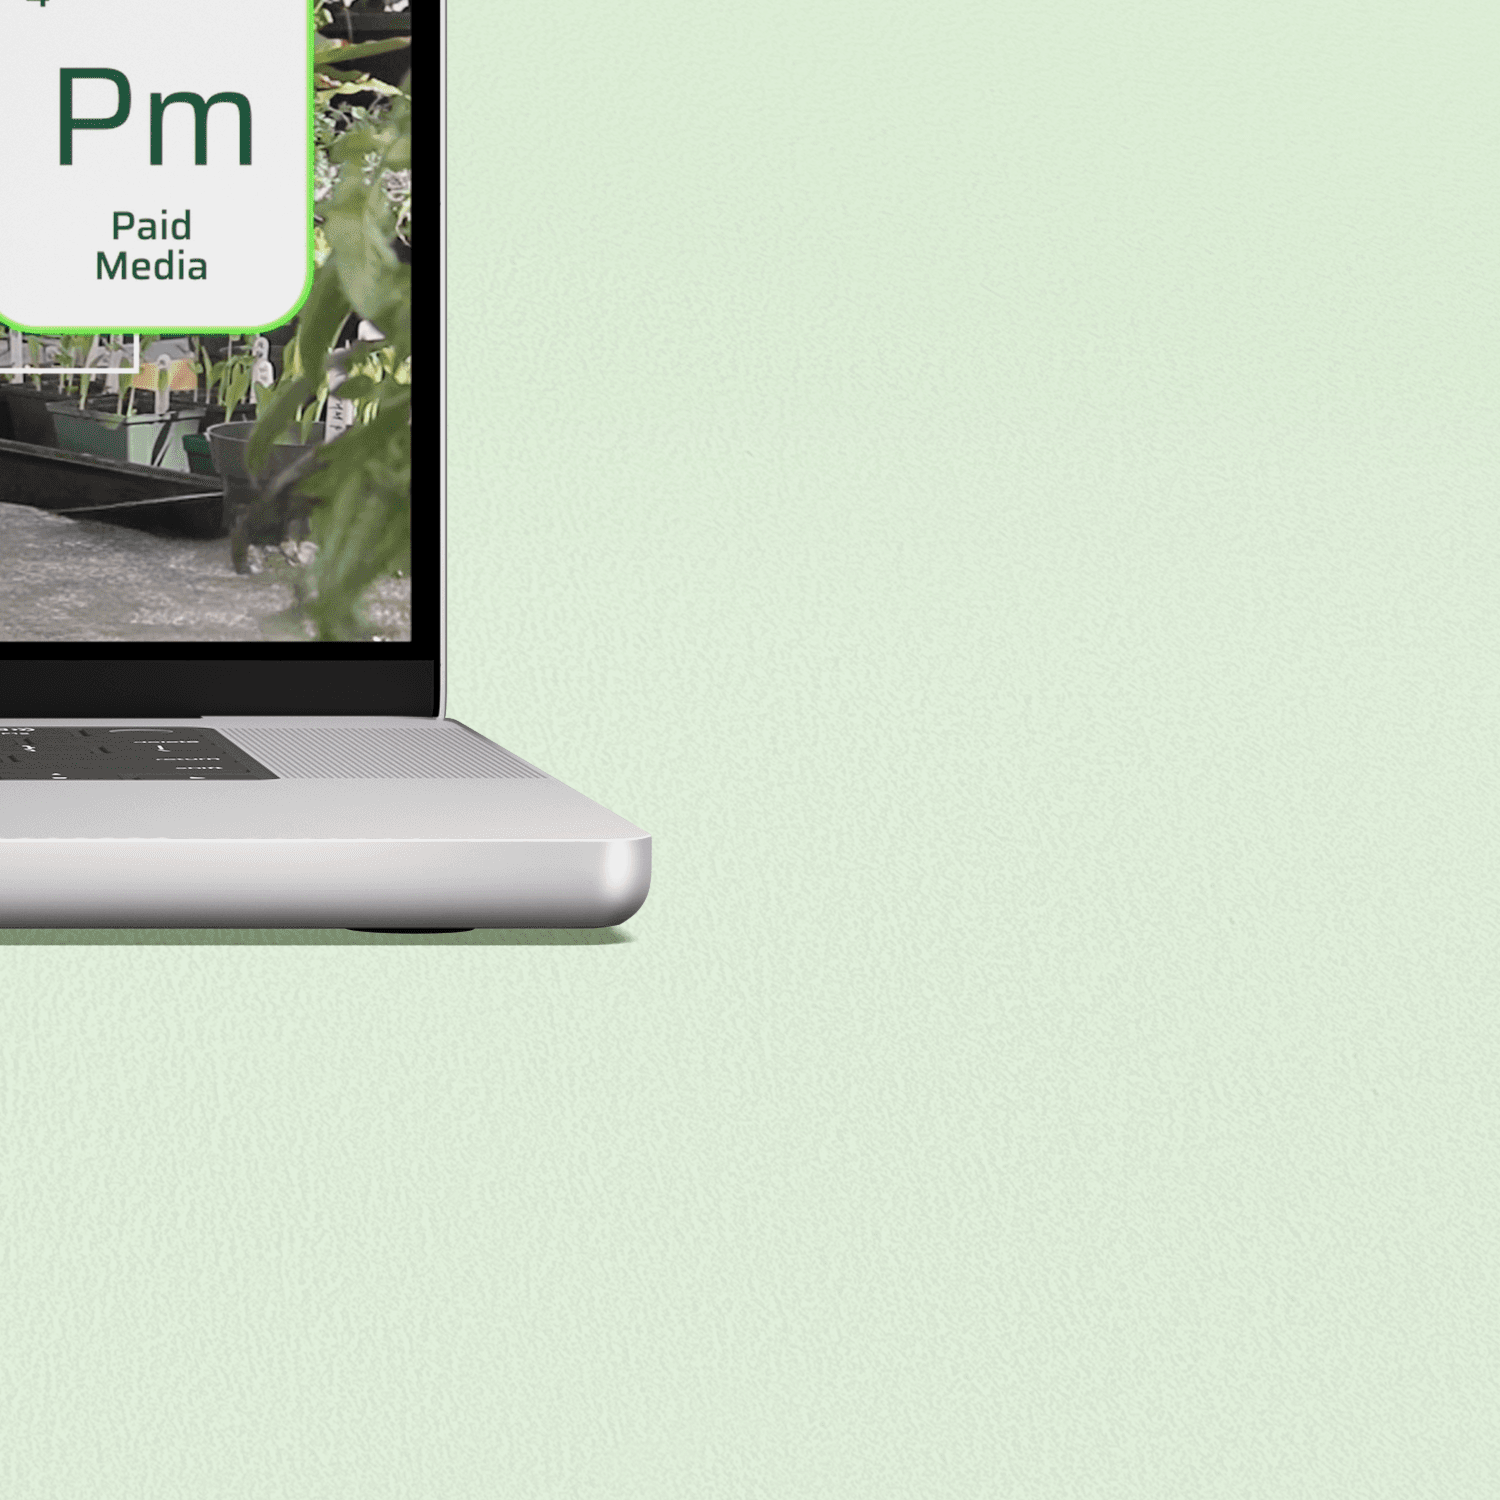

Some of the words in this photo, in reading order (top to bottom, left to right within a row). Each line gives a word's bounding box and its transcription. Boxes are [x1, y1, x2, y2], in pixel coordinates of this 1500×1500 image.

[59, 67, 252, 166] Pm
[113, 209, 191, 241] Paid
[96, 249, 207, 281] Media
